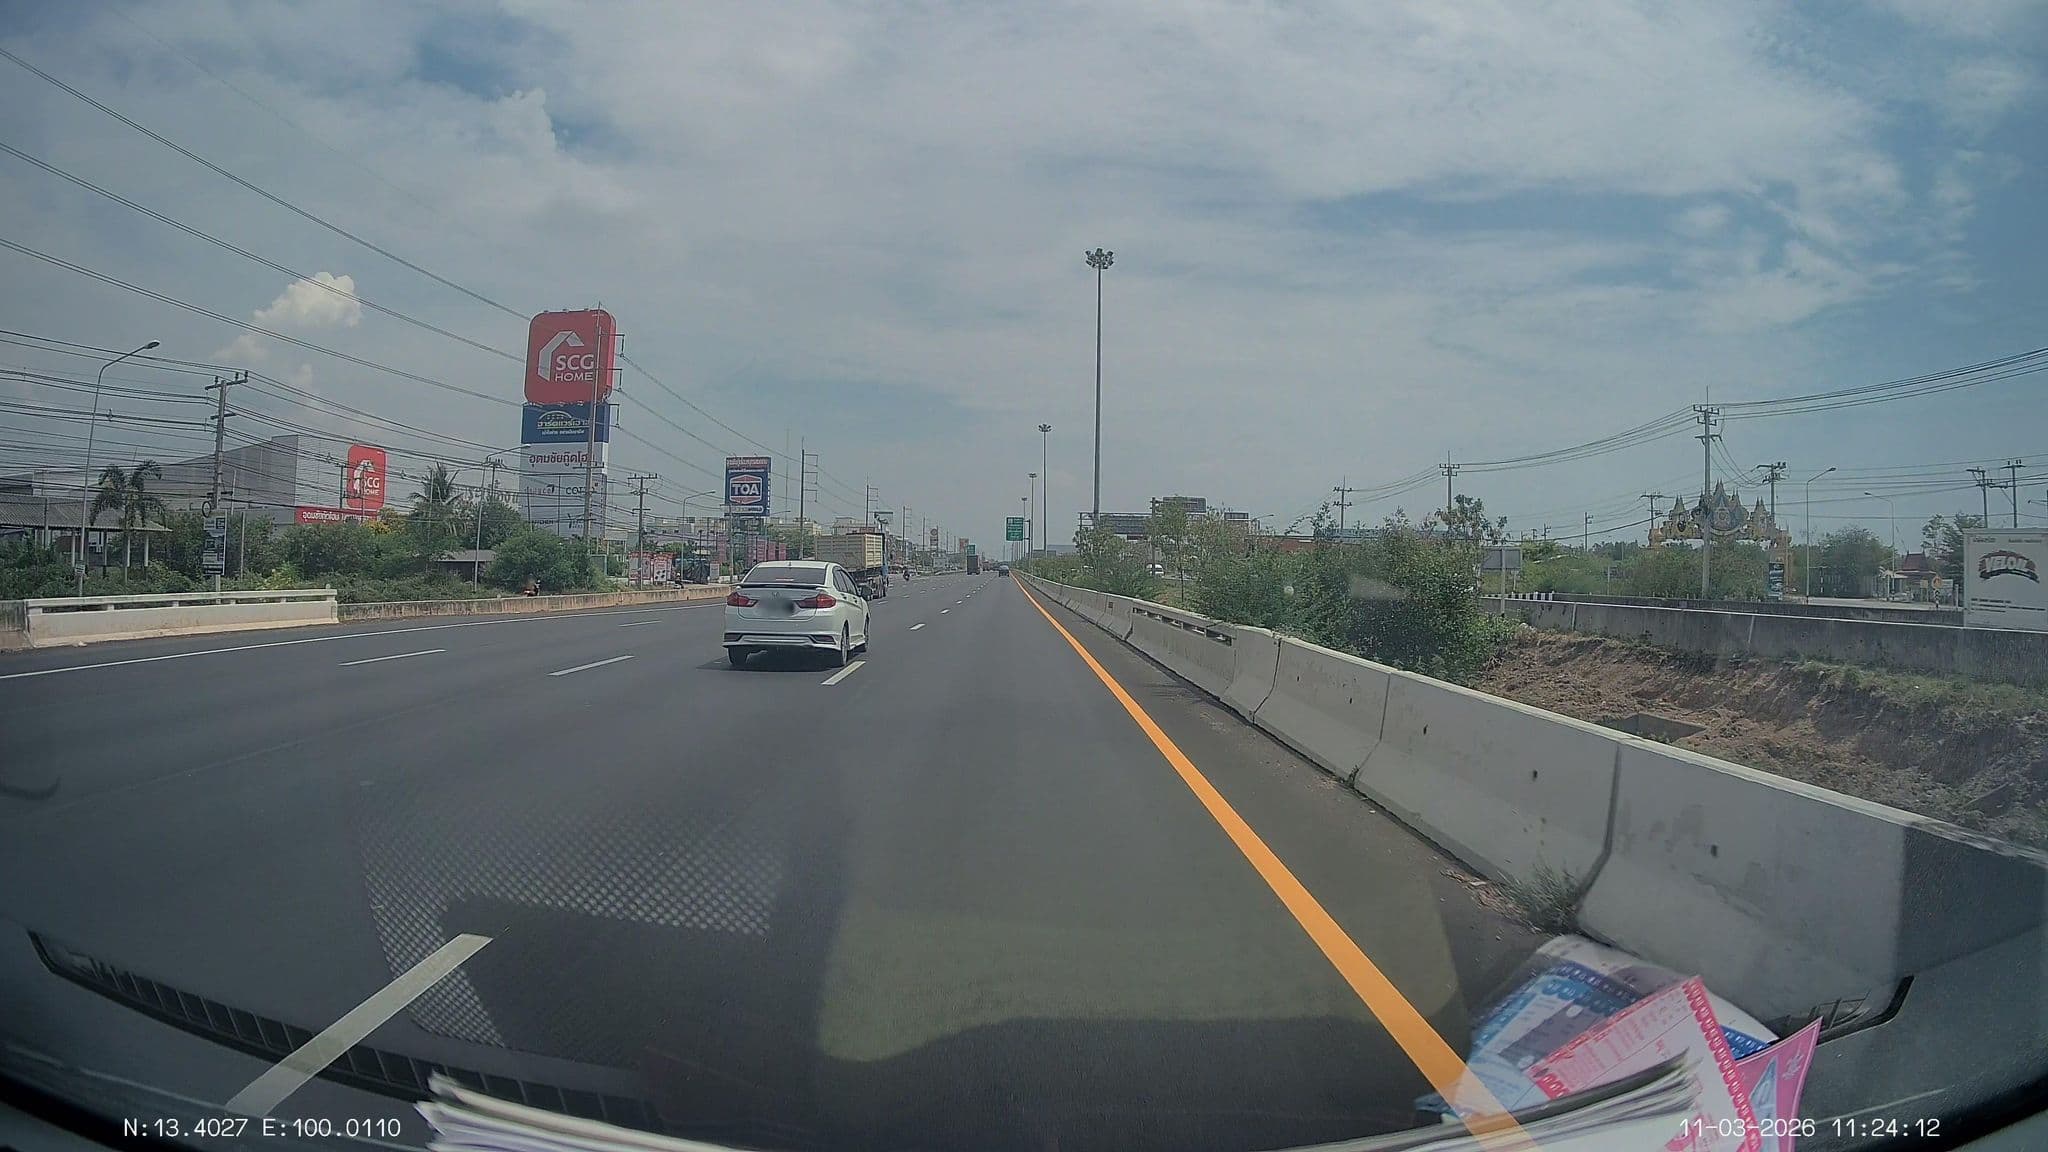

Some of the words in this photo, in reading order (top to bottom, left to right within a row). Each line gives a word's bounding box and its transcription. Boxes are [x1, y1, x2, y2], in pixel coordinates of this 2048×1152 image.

[556, 354, 594, 370] SCG
[555, 372, 594, 382] HOME
[529, 451, 592, 468] อุดมชัยกู๊ดโฮ
[732, 484, 759, 495] TOA
